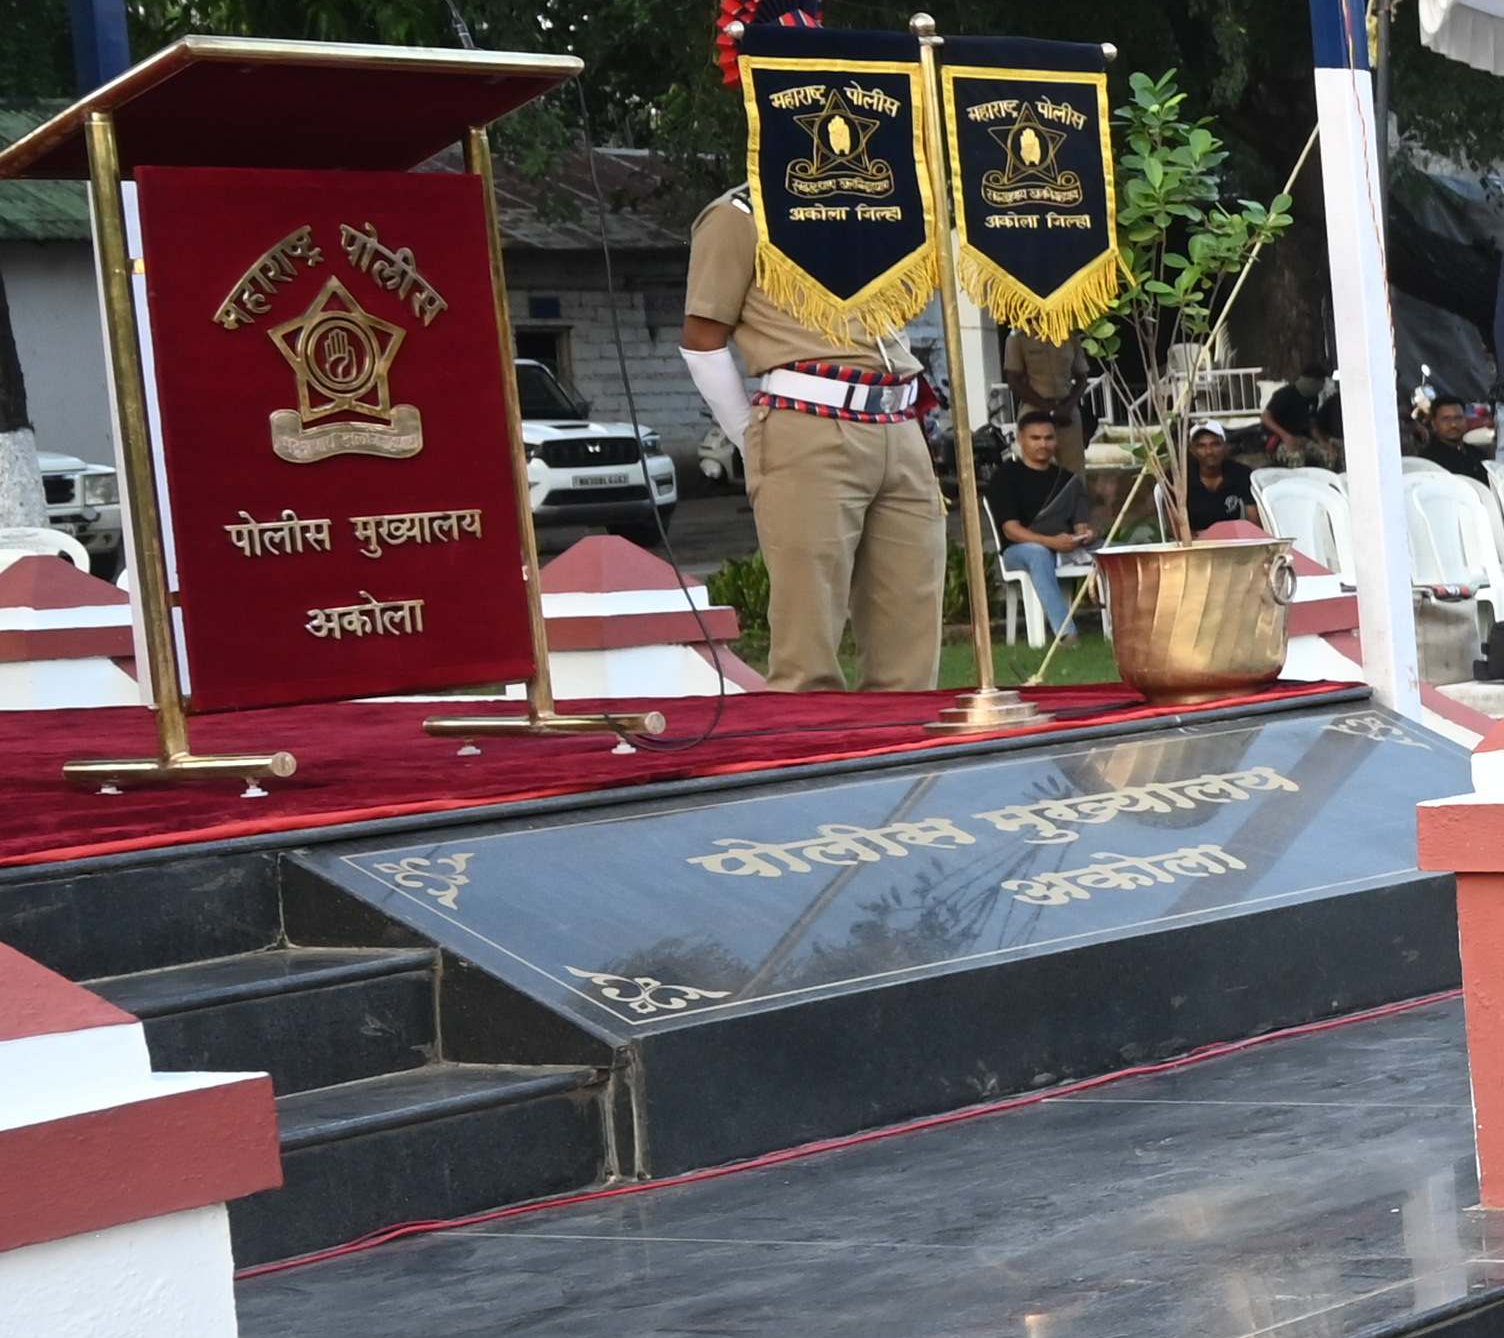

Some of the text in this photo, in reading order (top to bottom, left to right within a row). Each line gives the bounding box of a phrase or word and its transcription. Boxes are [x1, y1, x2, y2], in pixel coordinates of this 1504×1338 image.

[844, 80, 901, 117] पोलीस
[1035, 95, 1087, 130] पोलीस
[789, 203, 901, 221] अकोला जिल्हा
[984, 211, 1091, 229] अकोला जिल्हा
[212, 222, 448, 329] महाराष्ट्र पोलीस
[224, 509, 482, 558] पोलीस मुख्यालय
[305, 590, 424, 639] अकोला
[686, 766, 1299, 877] पोलीस मुख्यालय
[1001, 844, 1246, 905] अकोला
